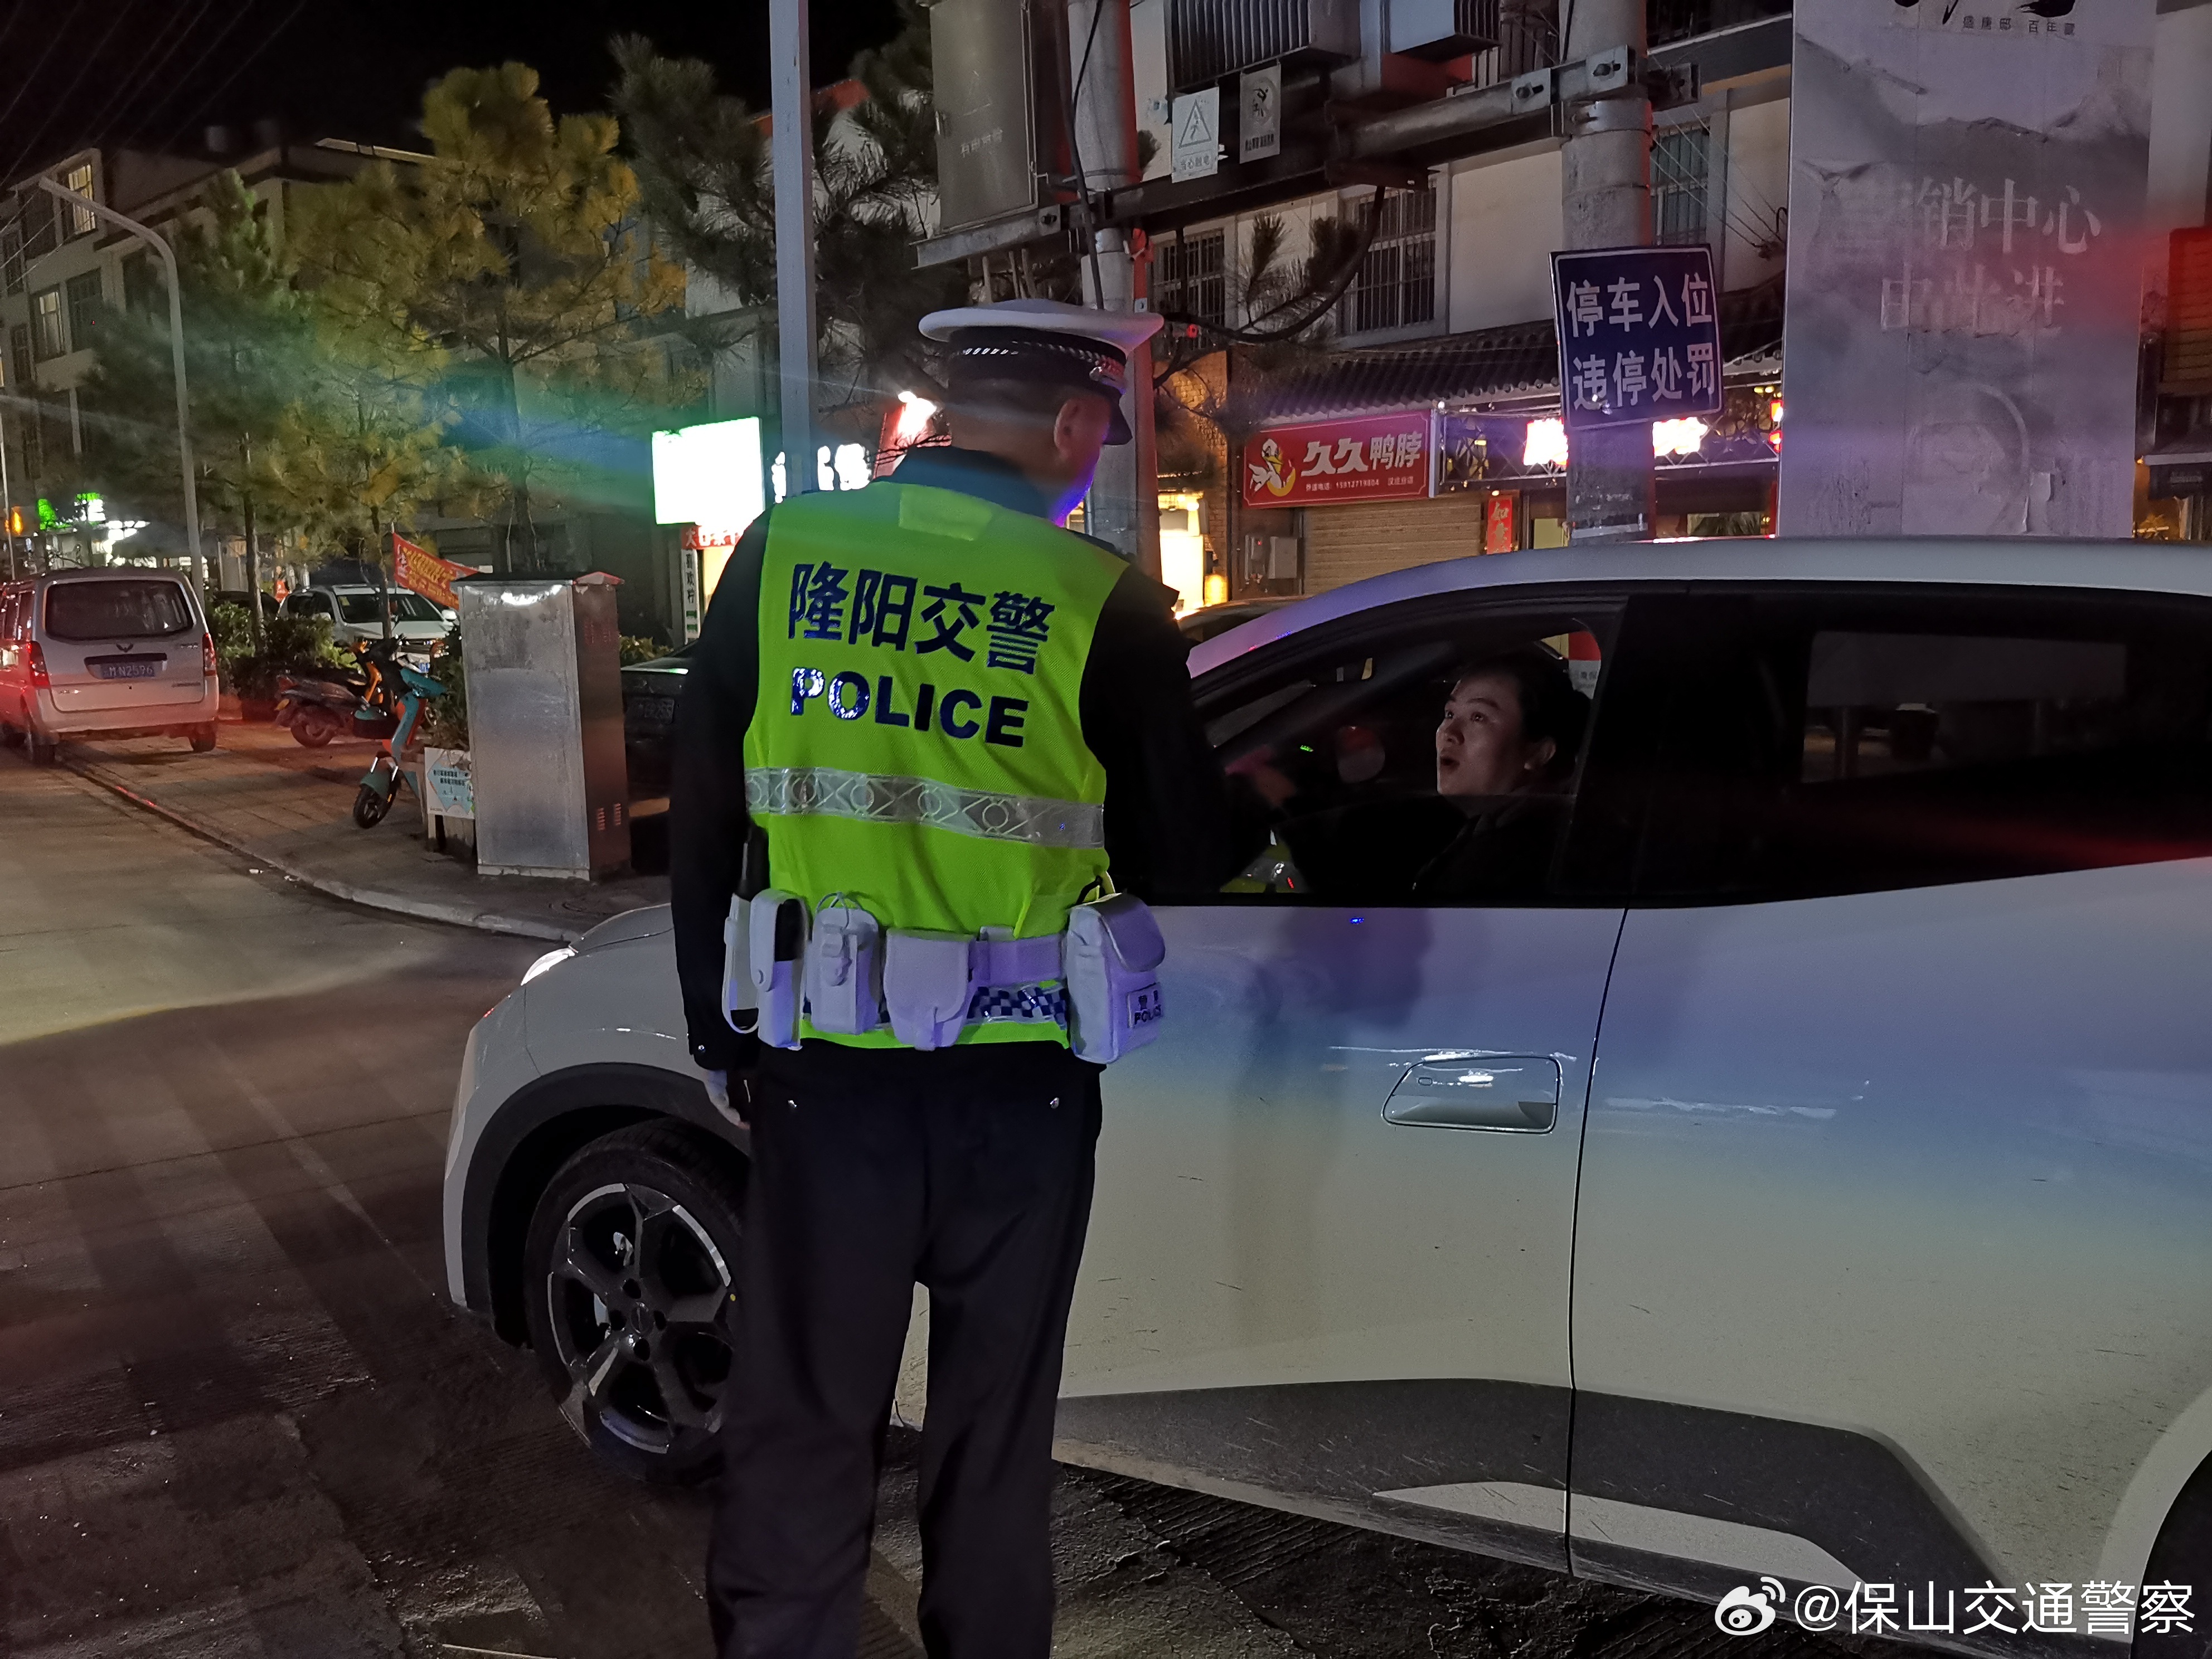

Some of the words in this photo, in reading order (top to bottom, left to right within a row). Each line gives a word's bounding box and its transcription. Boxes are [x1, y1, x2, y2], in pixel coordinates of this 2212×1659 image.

[1566, 271, 1713, 338] 停车入位
[1573, 342, 1716, 410] 违停处罚
[1301, 431, 1423, 477] 久久鸭脖
[787, 561, 1056, 675] 隆阳交警
[789, 667, 1030, 749] POLICE
